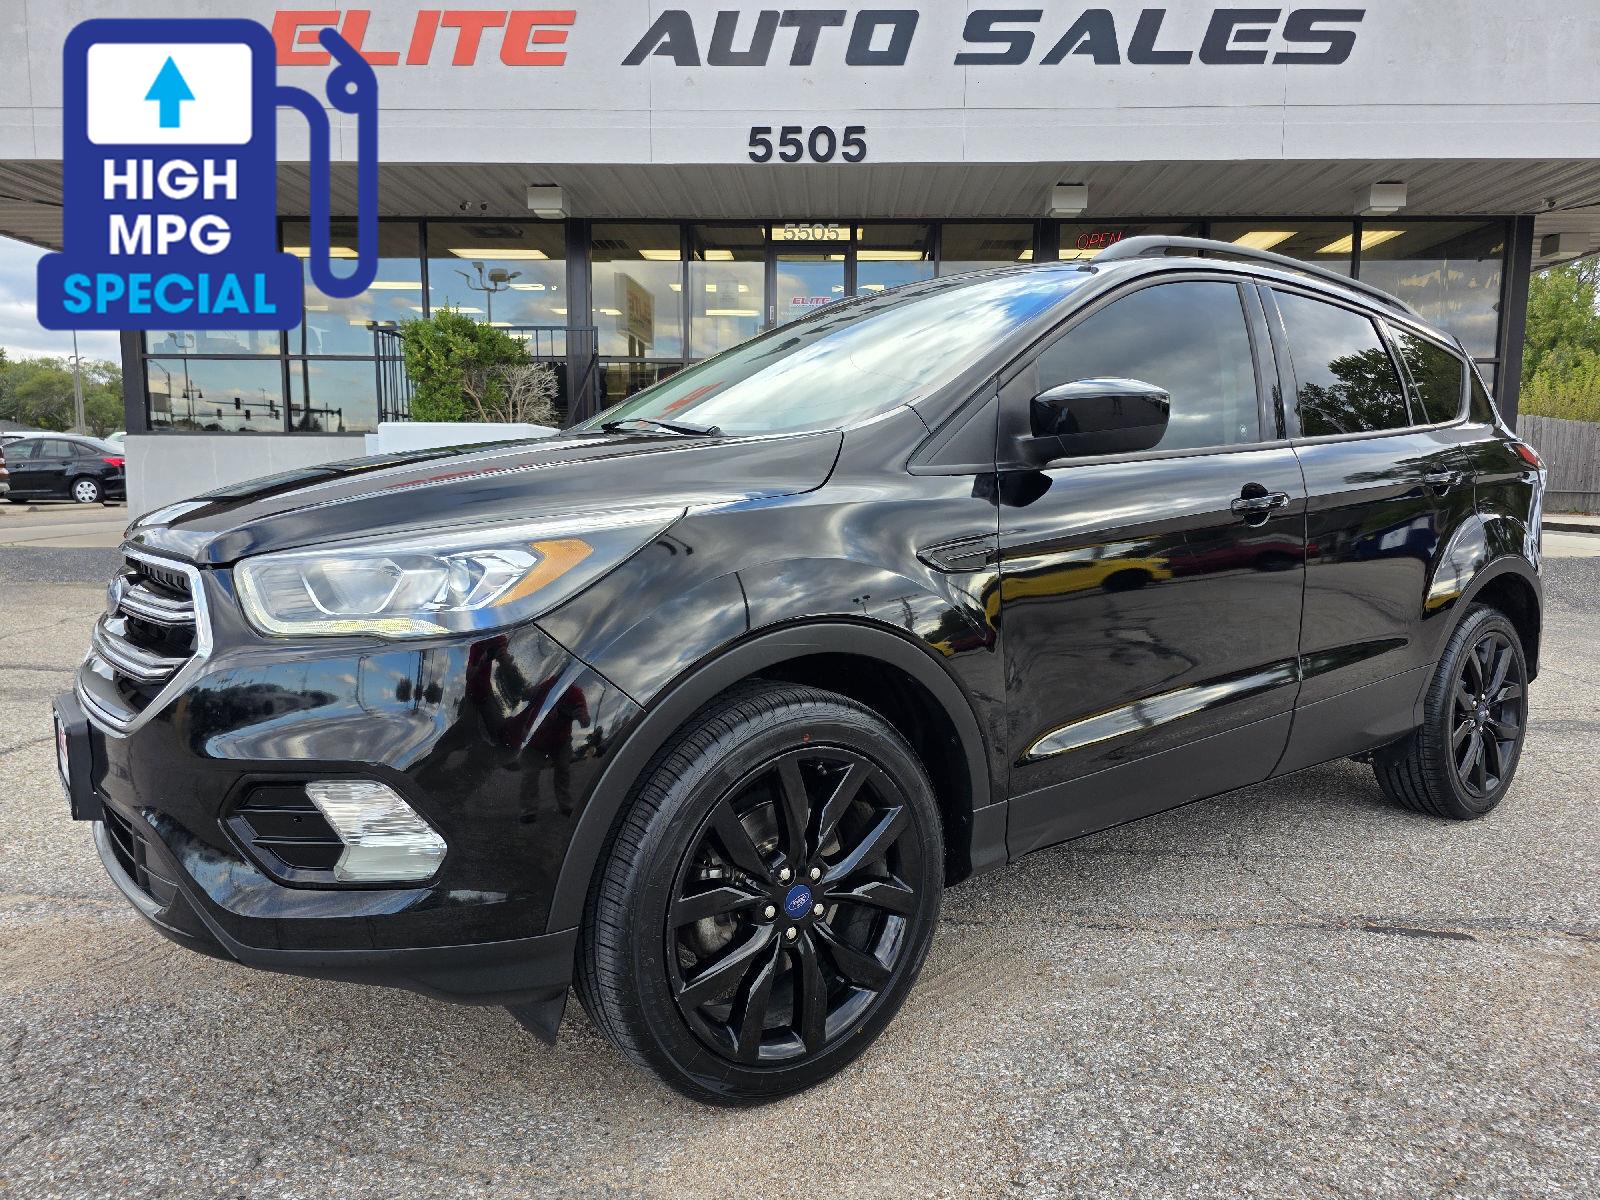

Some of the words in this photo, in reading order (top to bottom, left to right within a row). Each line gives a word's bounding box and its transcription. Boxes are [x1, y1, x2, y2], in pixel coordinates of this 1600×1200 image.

[271, 10, 577, 66] ELITE
[621, 9, 919, 66] AUTO
[954, 9, 1366, 65] SALES
[748, 125, 868, 163] 5505
[783, 223, 840, 241] 5505
[1077, 231, 1122, 250] OPEN
